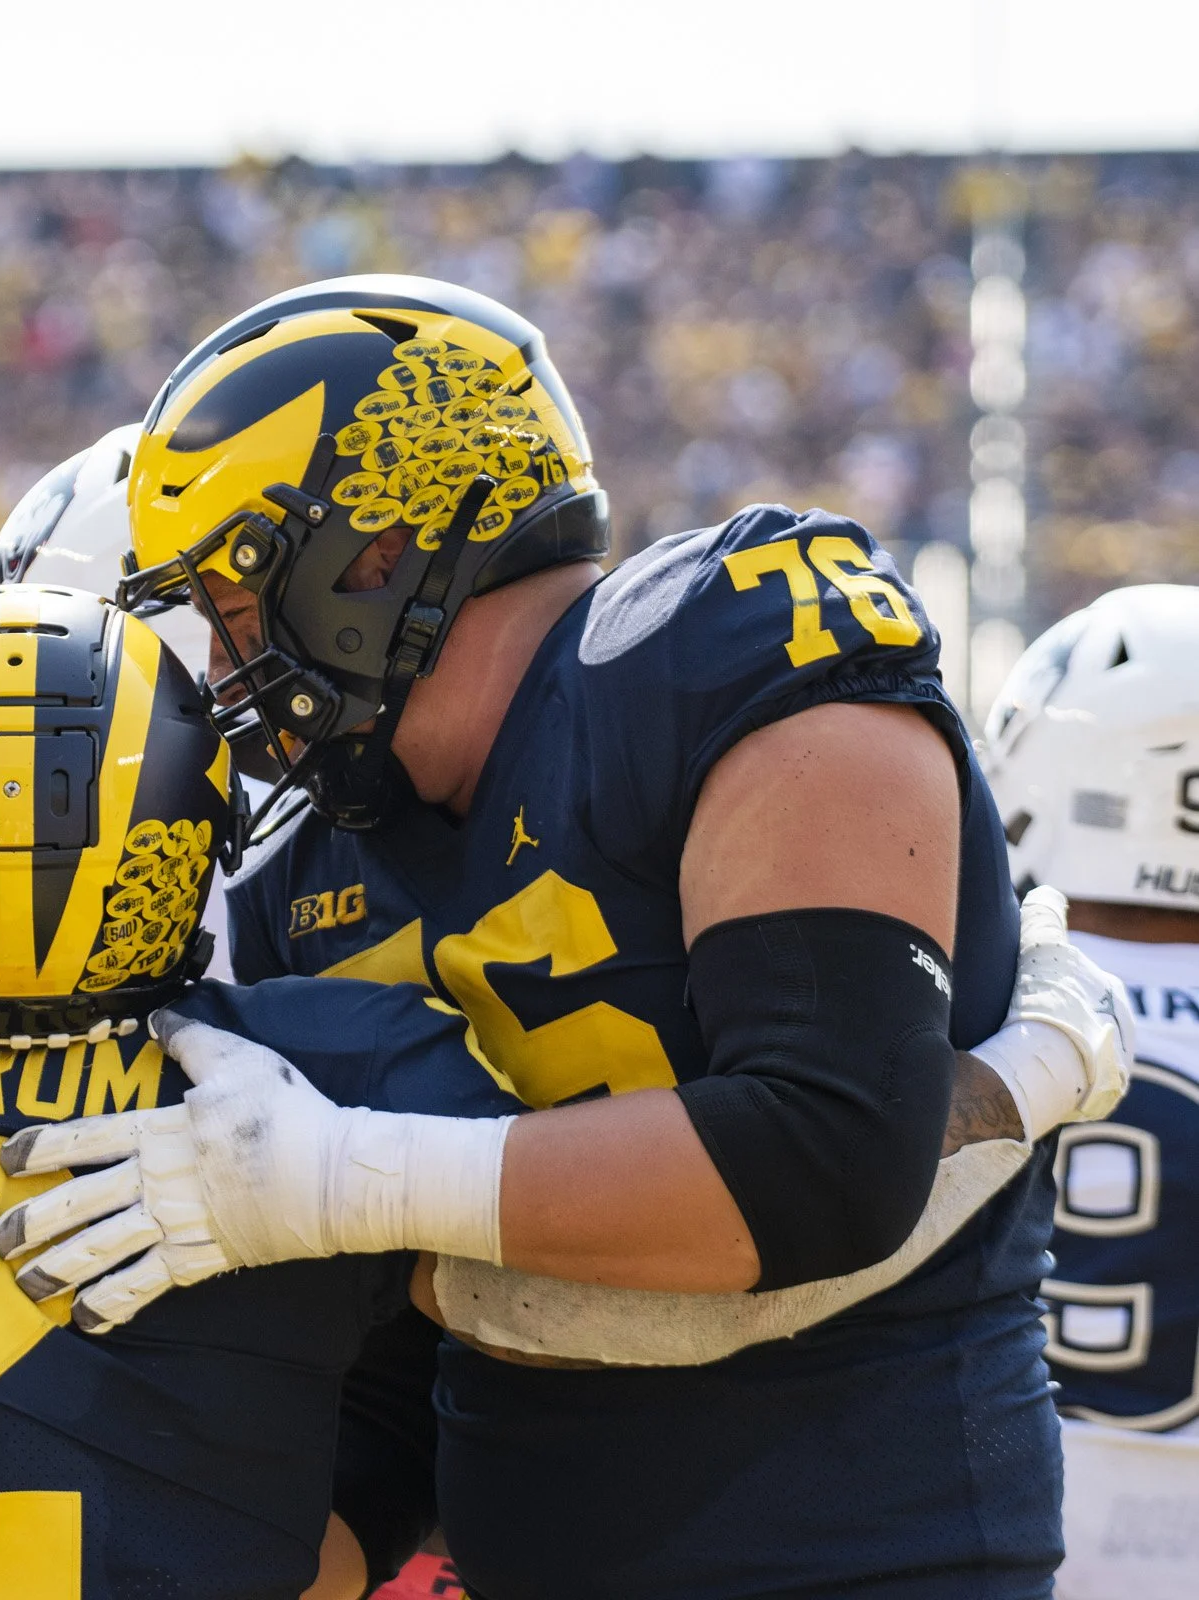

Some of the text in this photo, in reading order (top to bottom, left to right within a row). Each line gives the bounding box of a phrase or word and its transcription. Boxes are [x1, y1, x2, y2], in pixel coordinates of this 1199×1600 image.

[416, 463, 430, 475] 971
[534, 452, 563, 486] 76
[472, 512, 504, 535] TED
[722, 536, 922, 668] 76
[104, 918, 137, 943] (540)
[138, 947, 163, 970] TED
